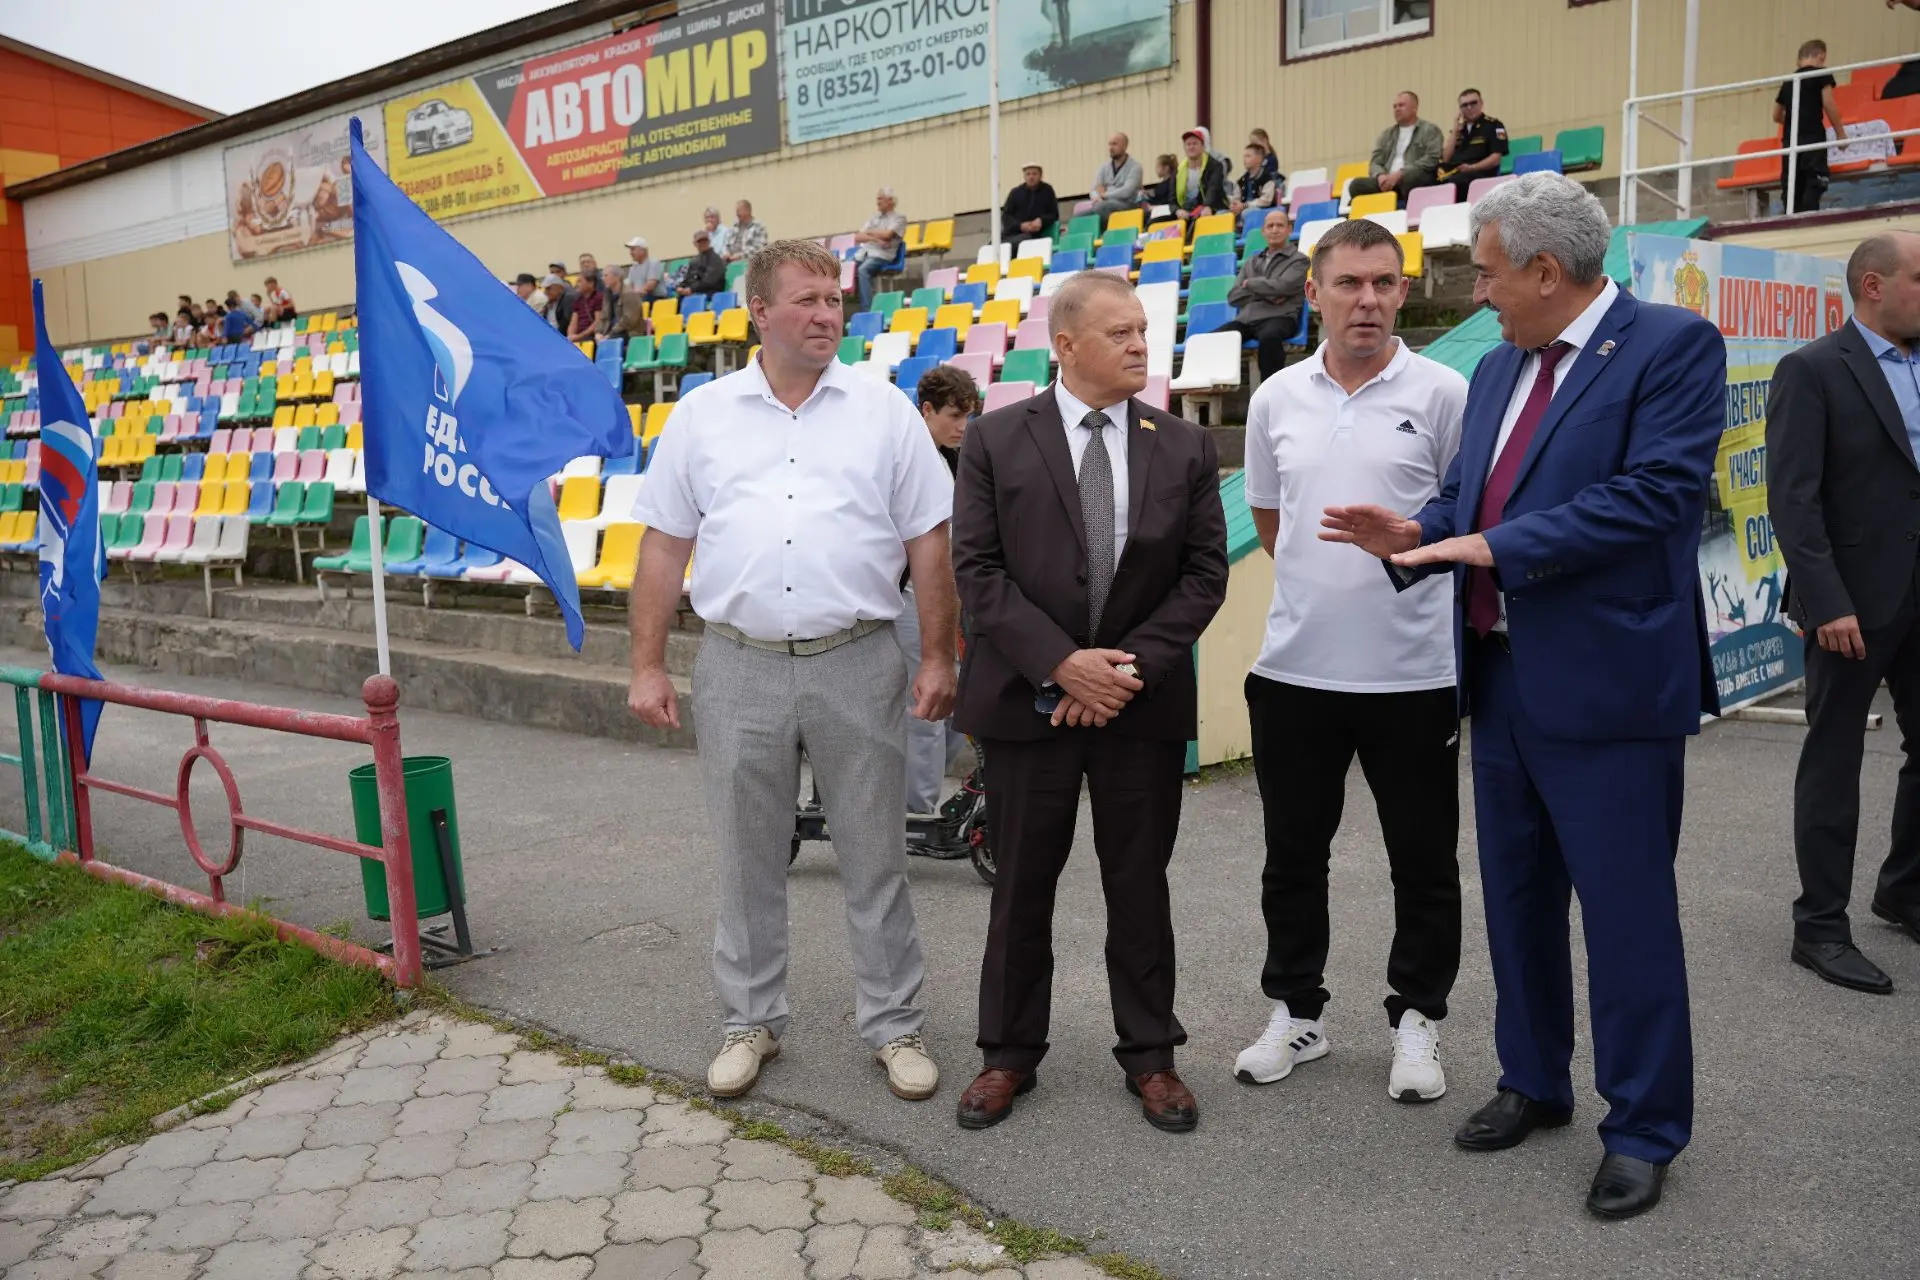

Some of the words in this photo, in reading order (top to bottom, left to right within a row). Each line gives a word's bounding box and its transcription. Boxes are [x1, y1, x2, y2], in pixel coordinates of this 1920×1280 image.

[496, 73, 525, 90] МАСЛА
[529, 52, 600, 80] АККУМУЛЯТОРЫ
[603, 38, 641, 59] КРАСКИ
[645, 26, 682, 47] ХИМИЯ
[686, 15, 721, 36] ШИНЫ
[726, 3, 765, 26] ДИСКИ
[795, 0, 989, 59] НАРКОТИКО
[796, 59, 846, 79] СООБЩИ,
[848, 52, 867, 68] ГДЕ
[872, 39, 922, 62] ТОРГУЮТ
[926, 22, 989, 48] СМЕРТЬЮ!
[524, 30, 767, 148] АВТОМИР
[798, 84, 809, 106] 8
[817, 66, 880, 108] (8352)
[887, 42, 986, 87] 23-01-00
[547, 137, 628, 167] АВТОЗАПЧАСТИ
[630, 134, 647, 148] НА
[648, 109, 752, 143] ОТЕЧЕСТВЕННЫЕ
[562, 167, 570, 181] И
[573, 152, 641, 180] ИМПОРТНЫЕ
[643, 134, 726, 164] АВТОМОБИЛИ
[1719, 277, 1818, 340] ШУМЕРЛЯ
[423, 441, 513, 511] РОСС
